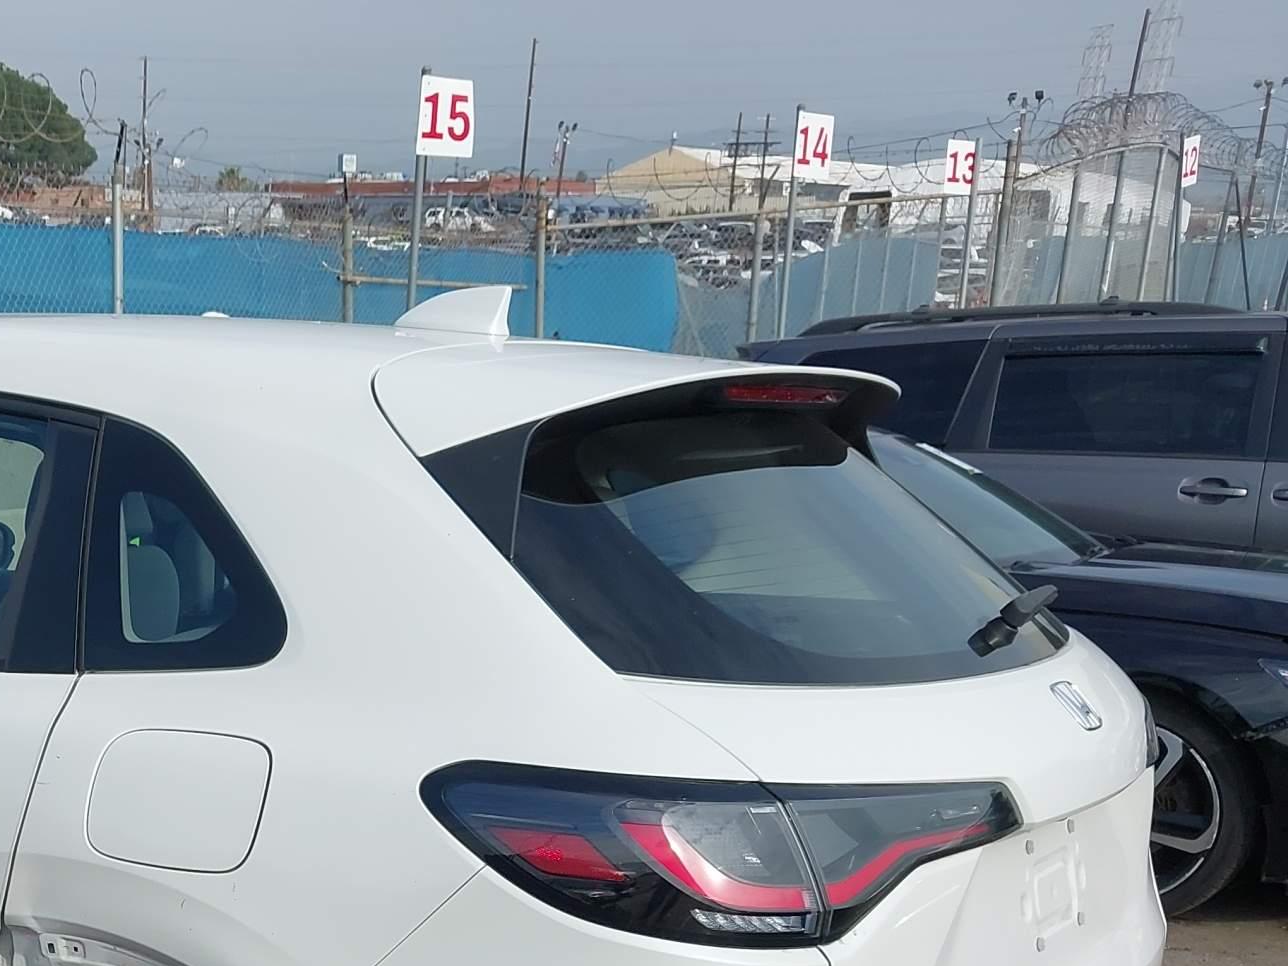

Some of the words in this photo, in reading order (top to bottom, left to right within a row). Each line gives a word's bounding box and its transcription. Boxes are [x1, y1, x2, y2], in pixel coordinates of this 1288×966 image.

[421, 92, 470, 142] 15
[797, 125, 828, 168] 14
[1183, 146, 1198, 178] 12
[947, 150, 976, 185] 13
